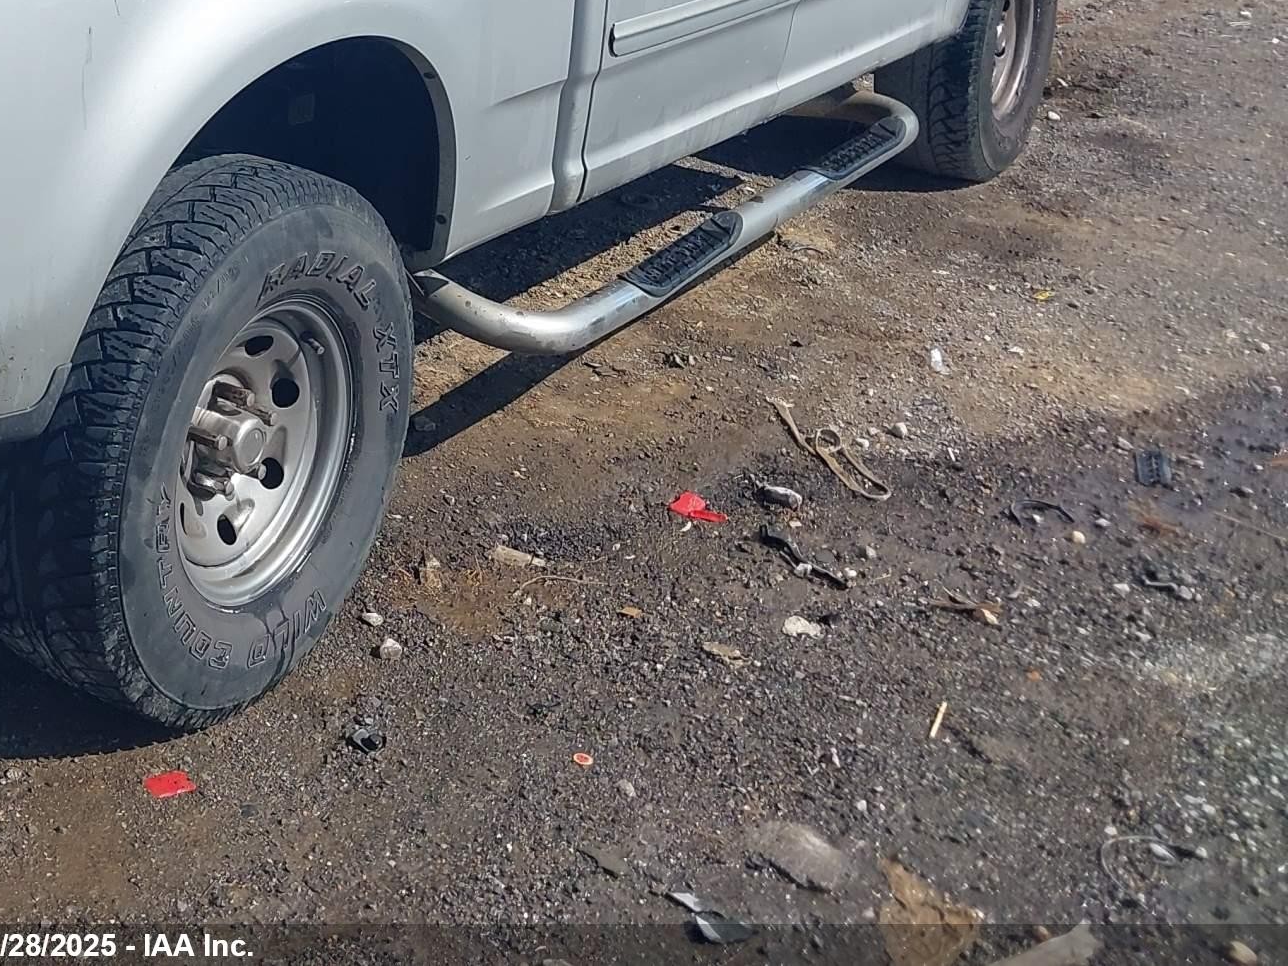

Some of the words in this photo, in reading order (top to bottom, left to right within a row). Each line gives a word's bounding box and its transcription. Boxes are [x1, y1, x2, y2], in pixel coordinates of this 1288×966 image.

[255, 249, 377, 312] RADIAL
[372, 321, 401, 414] XTX
[154, 482, 234, 671] COUNTRY
[245, 587, 328, 670] WILD
